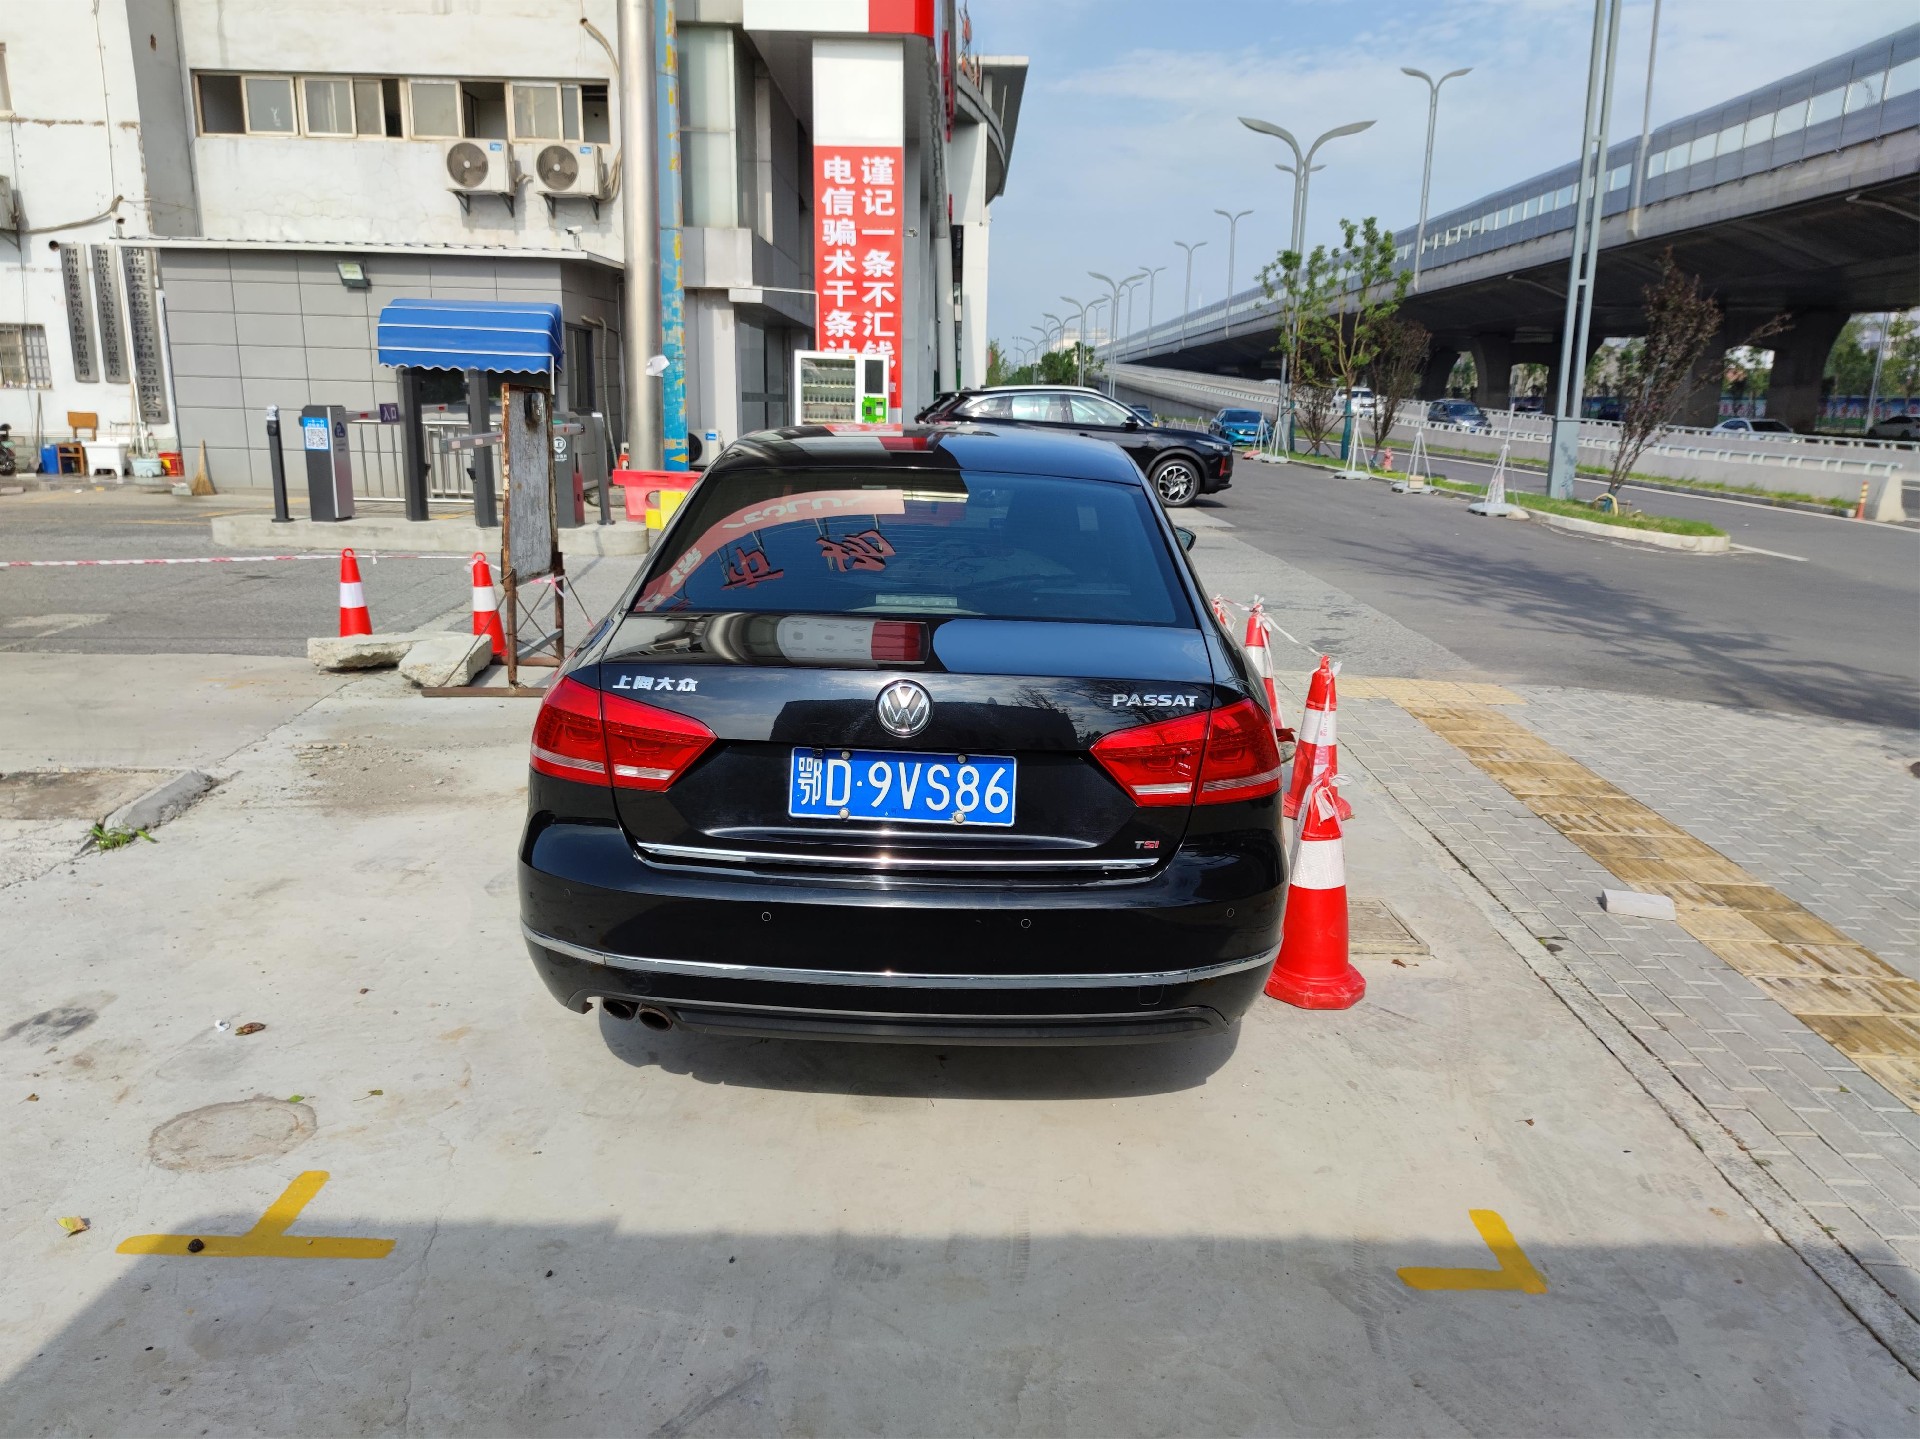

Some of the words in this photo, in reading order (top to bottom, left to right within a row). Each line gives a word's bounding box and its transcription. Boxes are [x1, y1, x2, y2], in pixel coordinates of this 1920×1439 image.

[383, 406, 397, 421] 入口
[612, 674, 698, 692] 上海大众
[1112, 693, 1199, 707] PASSAT
[1134, 840, 1160, 849] TSI
